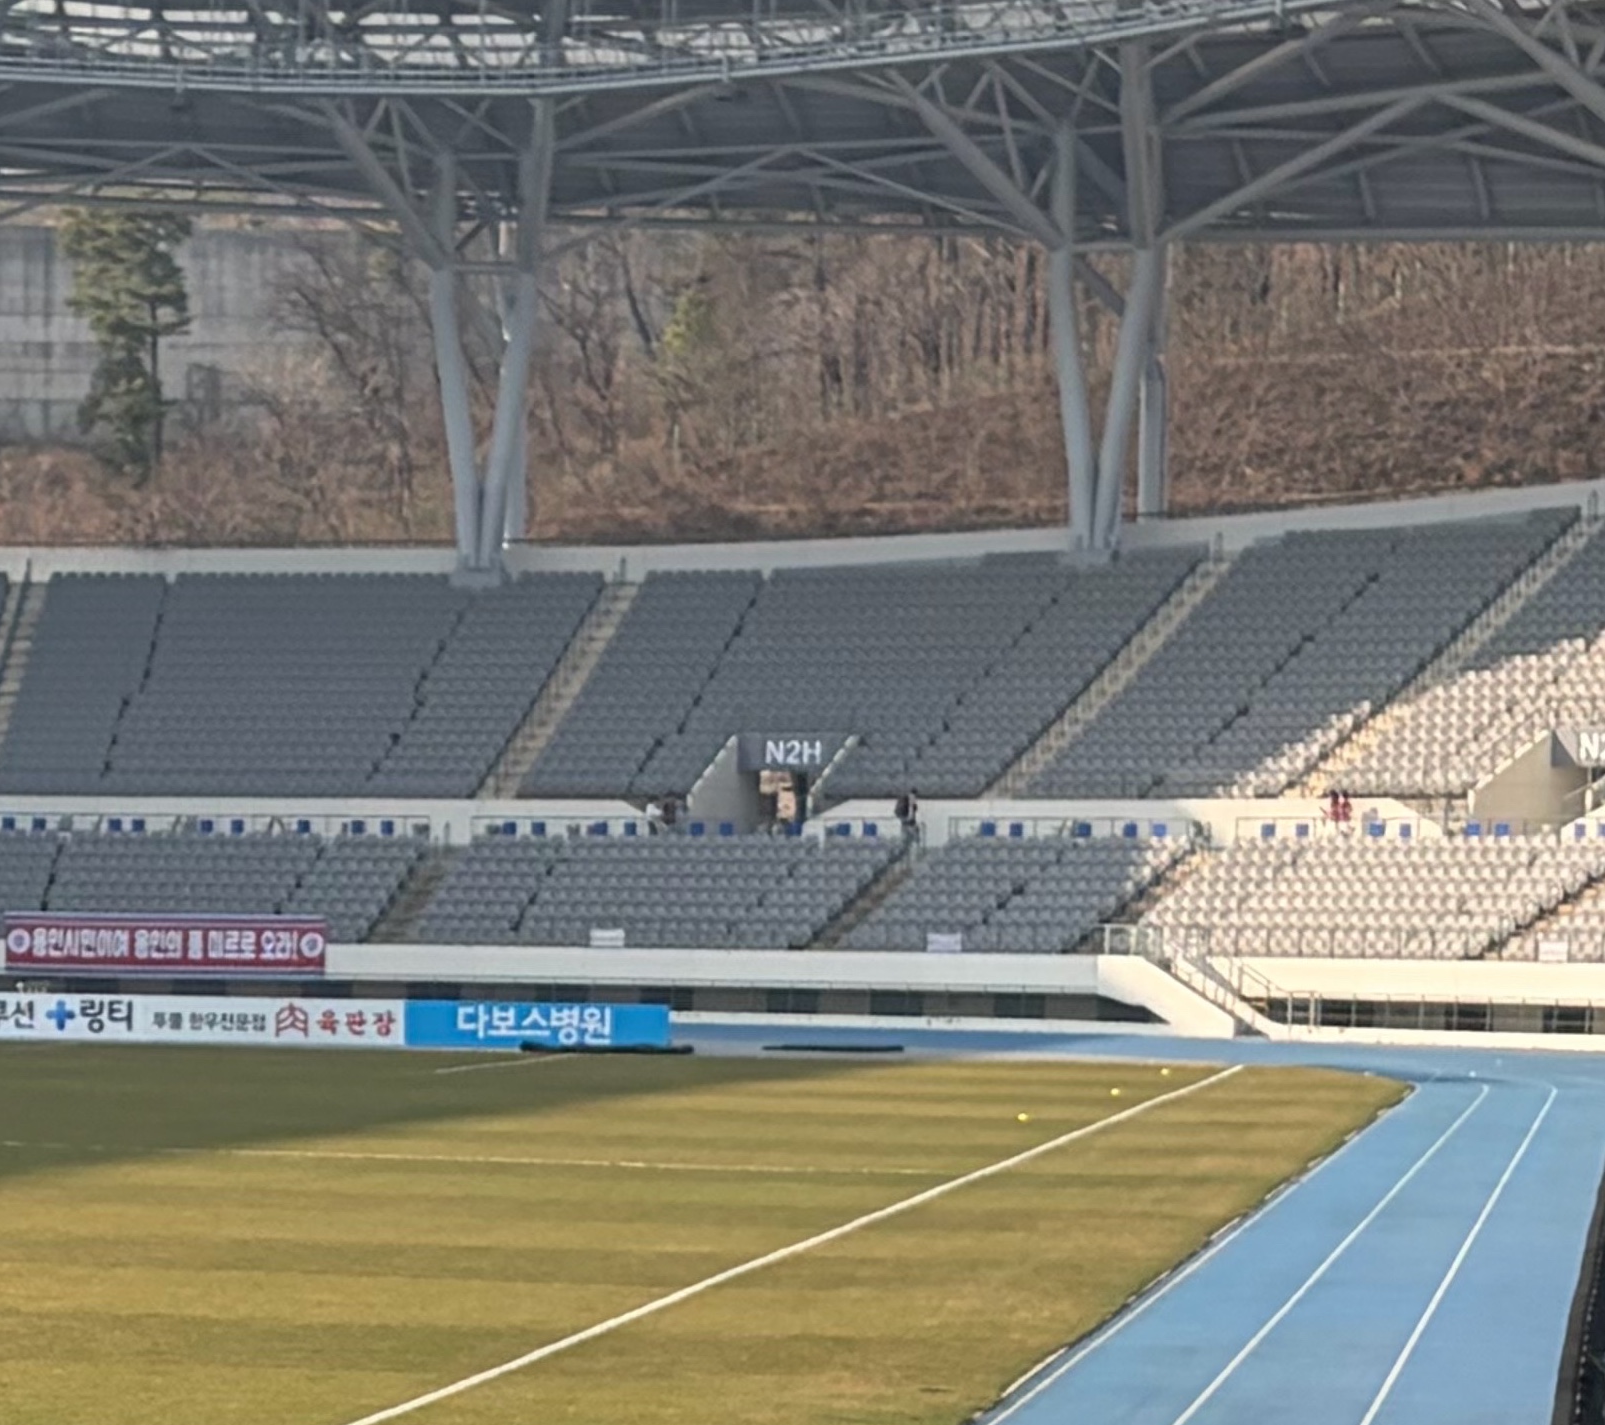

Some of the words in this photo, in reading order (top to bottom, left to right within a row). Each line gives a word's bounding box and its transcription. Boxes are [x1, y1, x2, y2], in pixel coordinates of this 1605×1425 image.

[765, 740, 821, 763] N2H
[1580, 732, 1605, 759] N
[80, 1000, 133, 1033] 링티
[457, 1005, 612, 1046] 다보스병원
